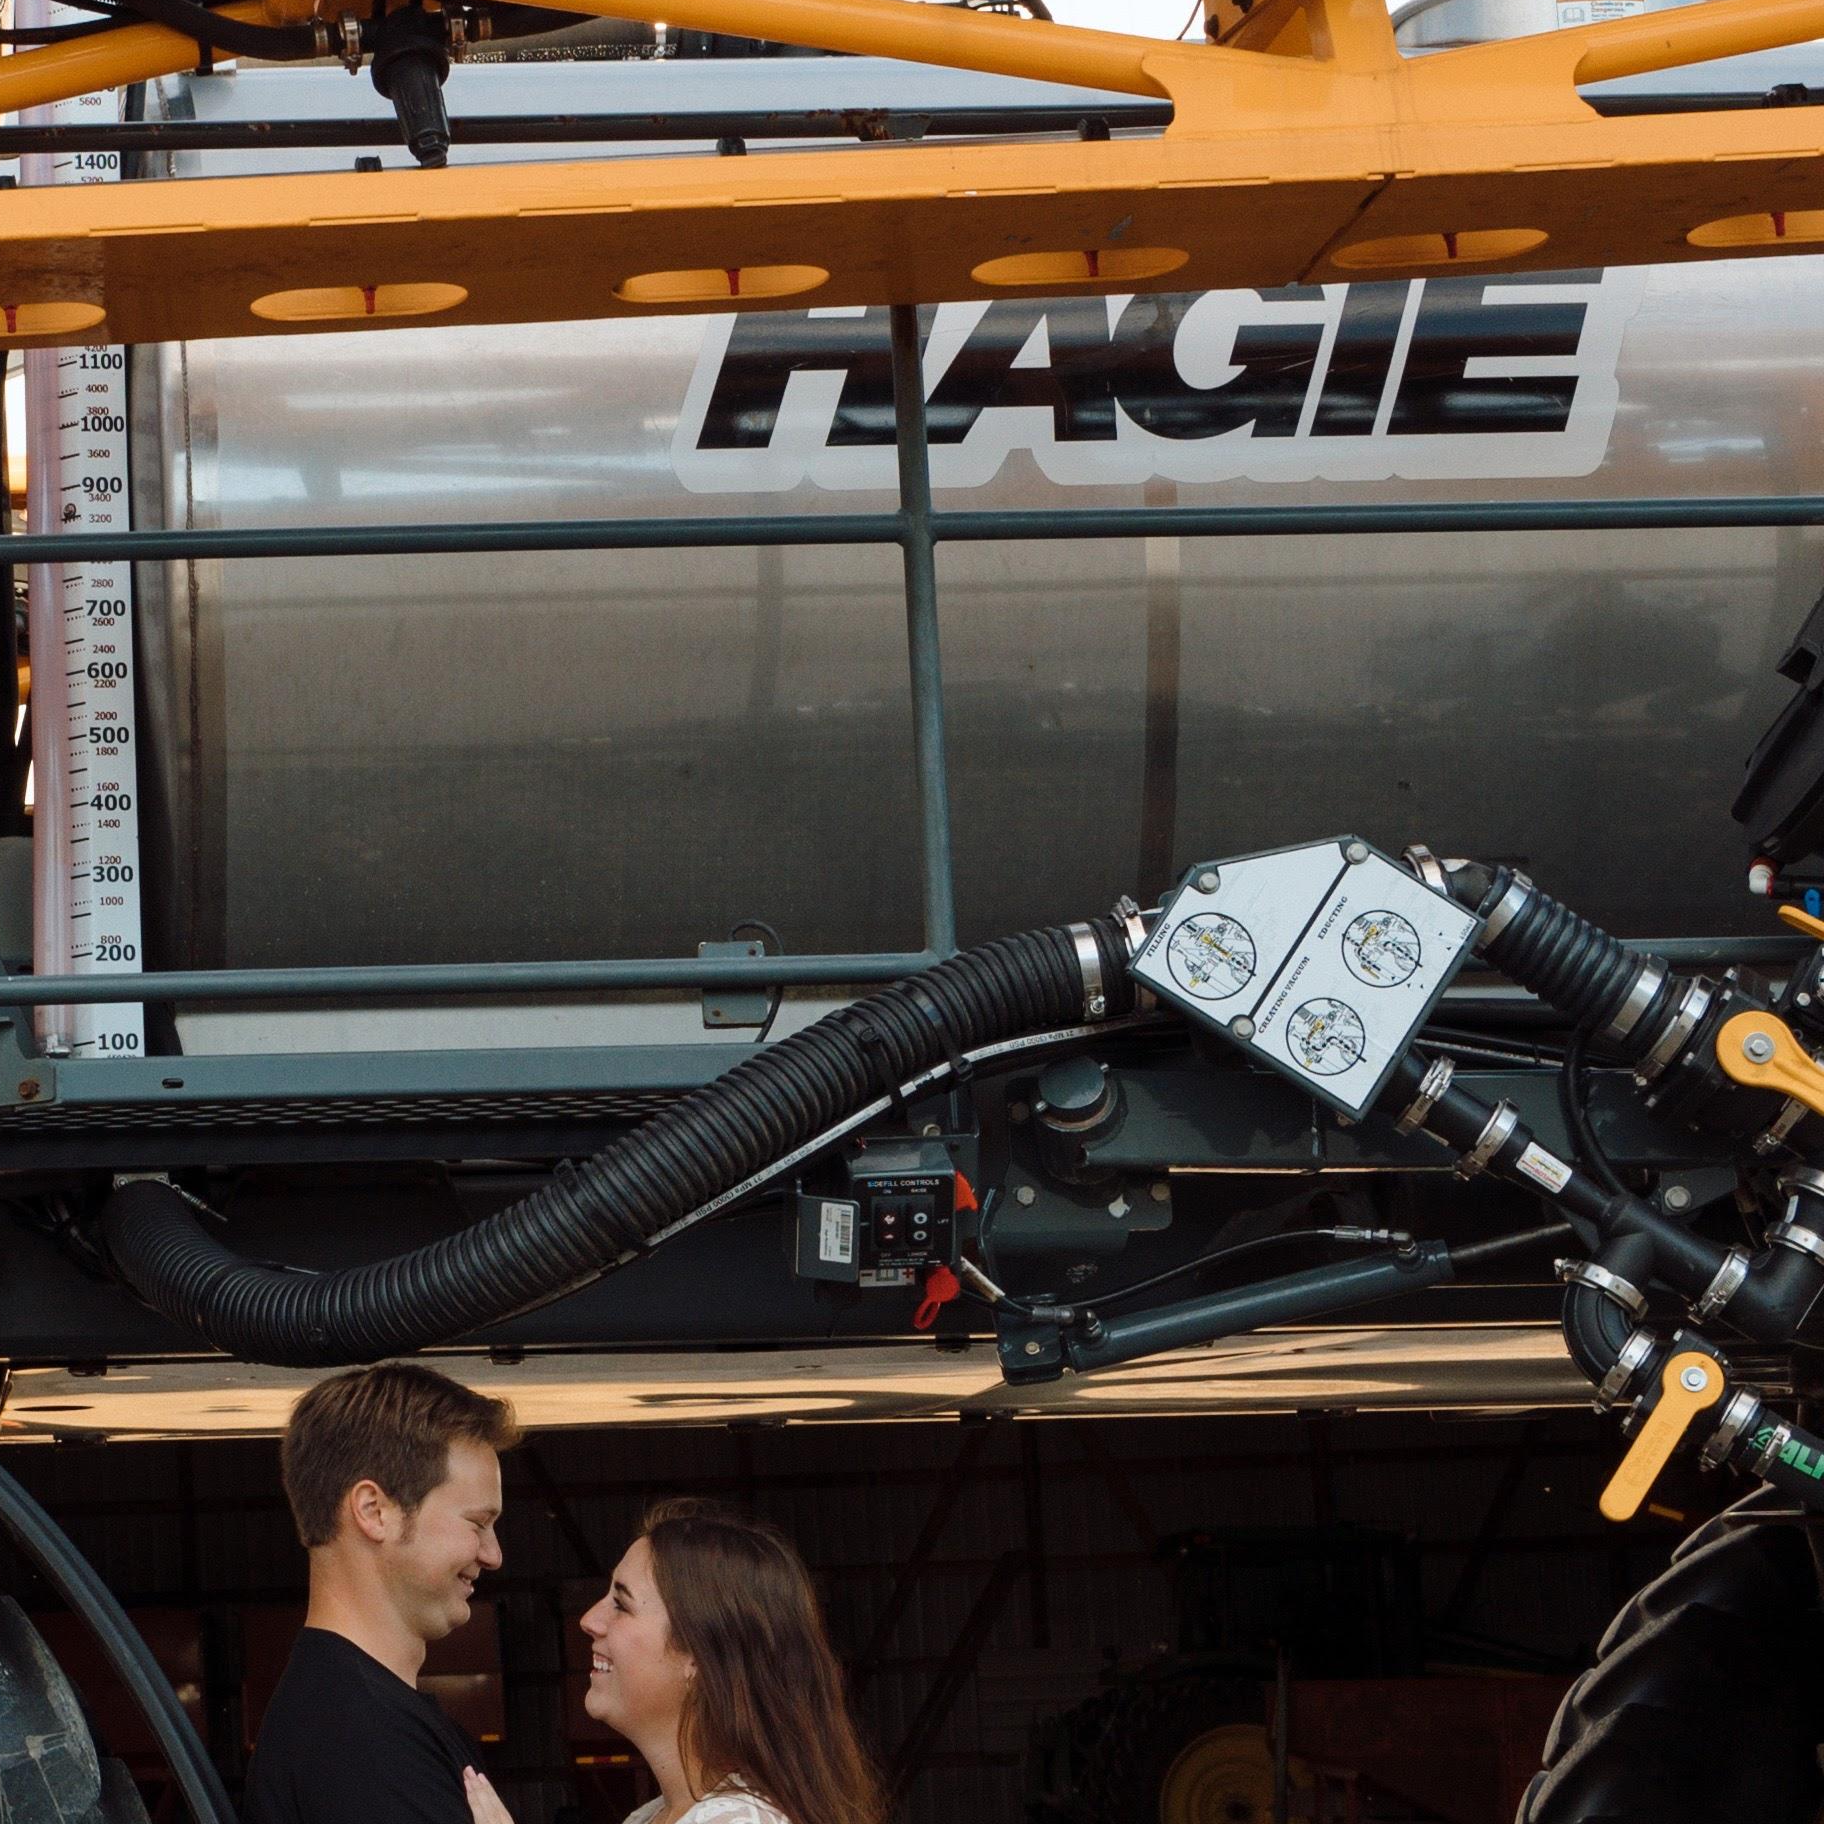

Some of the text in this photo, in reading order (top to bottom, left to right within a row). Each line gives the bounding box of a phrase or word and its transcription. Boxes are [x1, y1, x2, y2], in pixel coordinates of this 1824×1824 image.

[79, 97, 102, 106] 5600
[74, 153, 118, 170] 1400
[79, 354, 123, 369] 1100
[696, 265, 1606, 449] HAGIE
[85, 384, 109, 393] 4000
[86, 407, 109, 415] 3800
[80, 416, 125, 432] 1000
[87, 450, 110, 458] 3600
[82, 477, 123, 493] 900
[88, 494, 111, 502] 3400
[88, 514, 112, 523] 3200
[90, 579, 114, 587] 2800
[86, 600, 126, 616] 700
[92, 618, 115, 626] 2600
[93, 645, 115, 653] 2400
[87, 663, 128, 679] 600
[94, 680, 117, 688] 2200
[94, 712, 117, 720] 2000
[89, 727, 130, 744] 500
[95, 747, 118, 756] 1800
[96, 782, 119, 791] 1600
[90, 794, 132, 811] 400
[97, 819, 120, 828] 1400
[98, 856, 122, 864] 1200
[93, 866, 134, 883] 300
[100, 897, 124, 906] 1000
[1318, 896, 1348, 940] EDUCTING
[101, 936, 122, 944] 800
[1146, 923, 1172, 957] FILLING
[95, 944, 136, 962] 200
[1258, 956, 1310, 1034] CREATING VACUUM
[97, 1033, 139, 1050] 100
[867, 1178, 940, 1187] SIDEFILL CONTROLS
